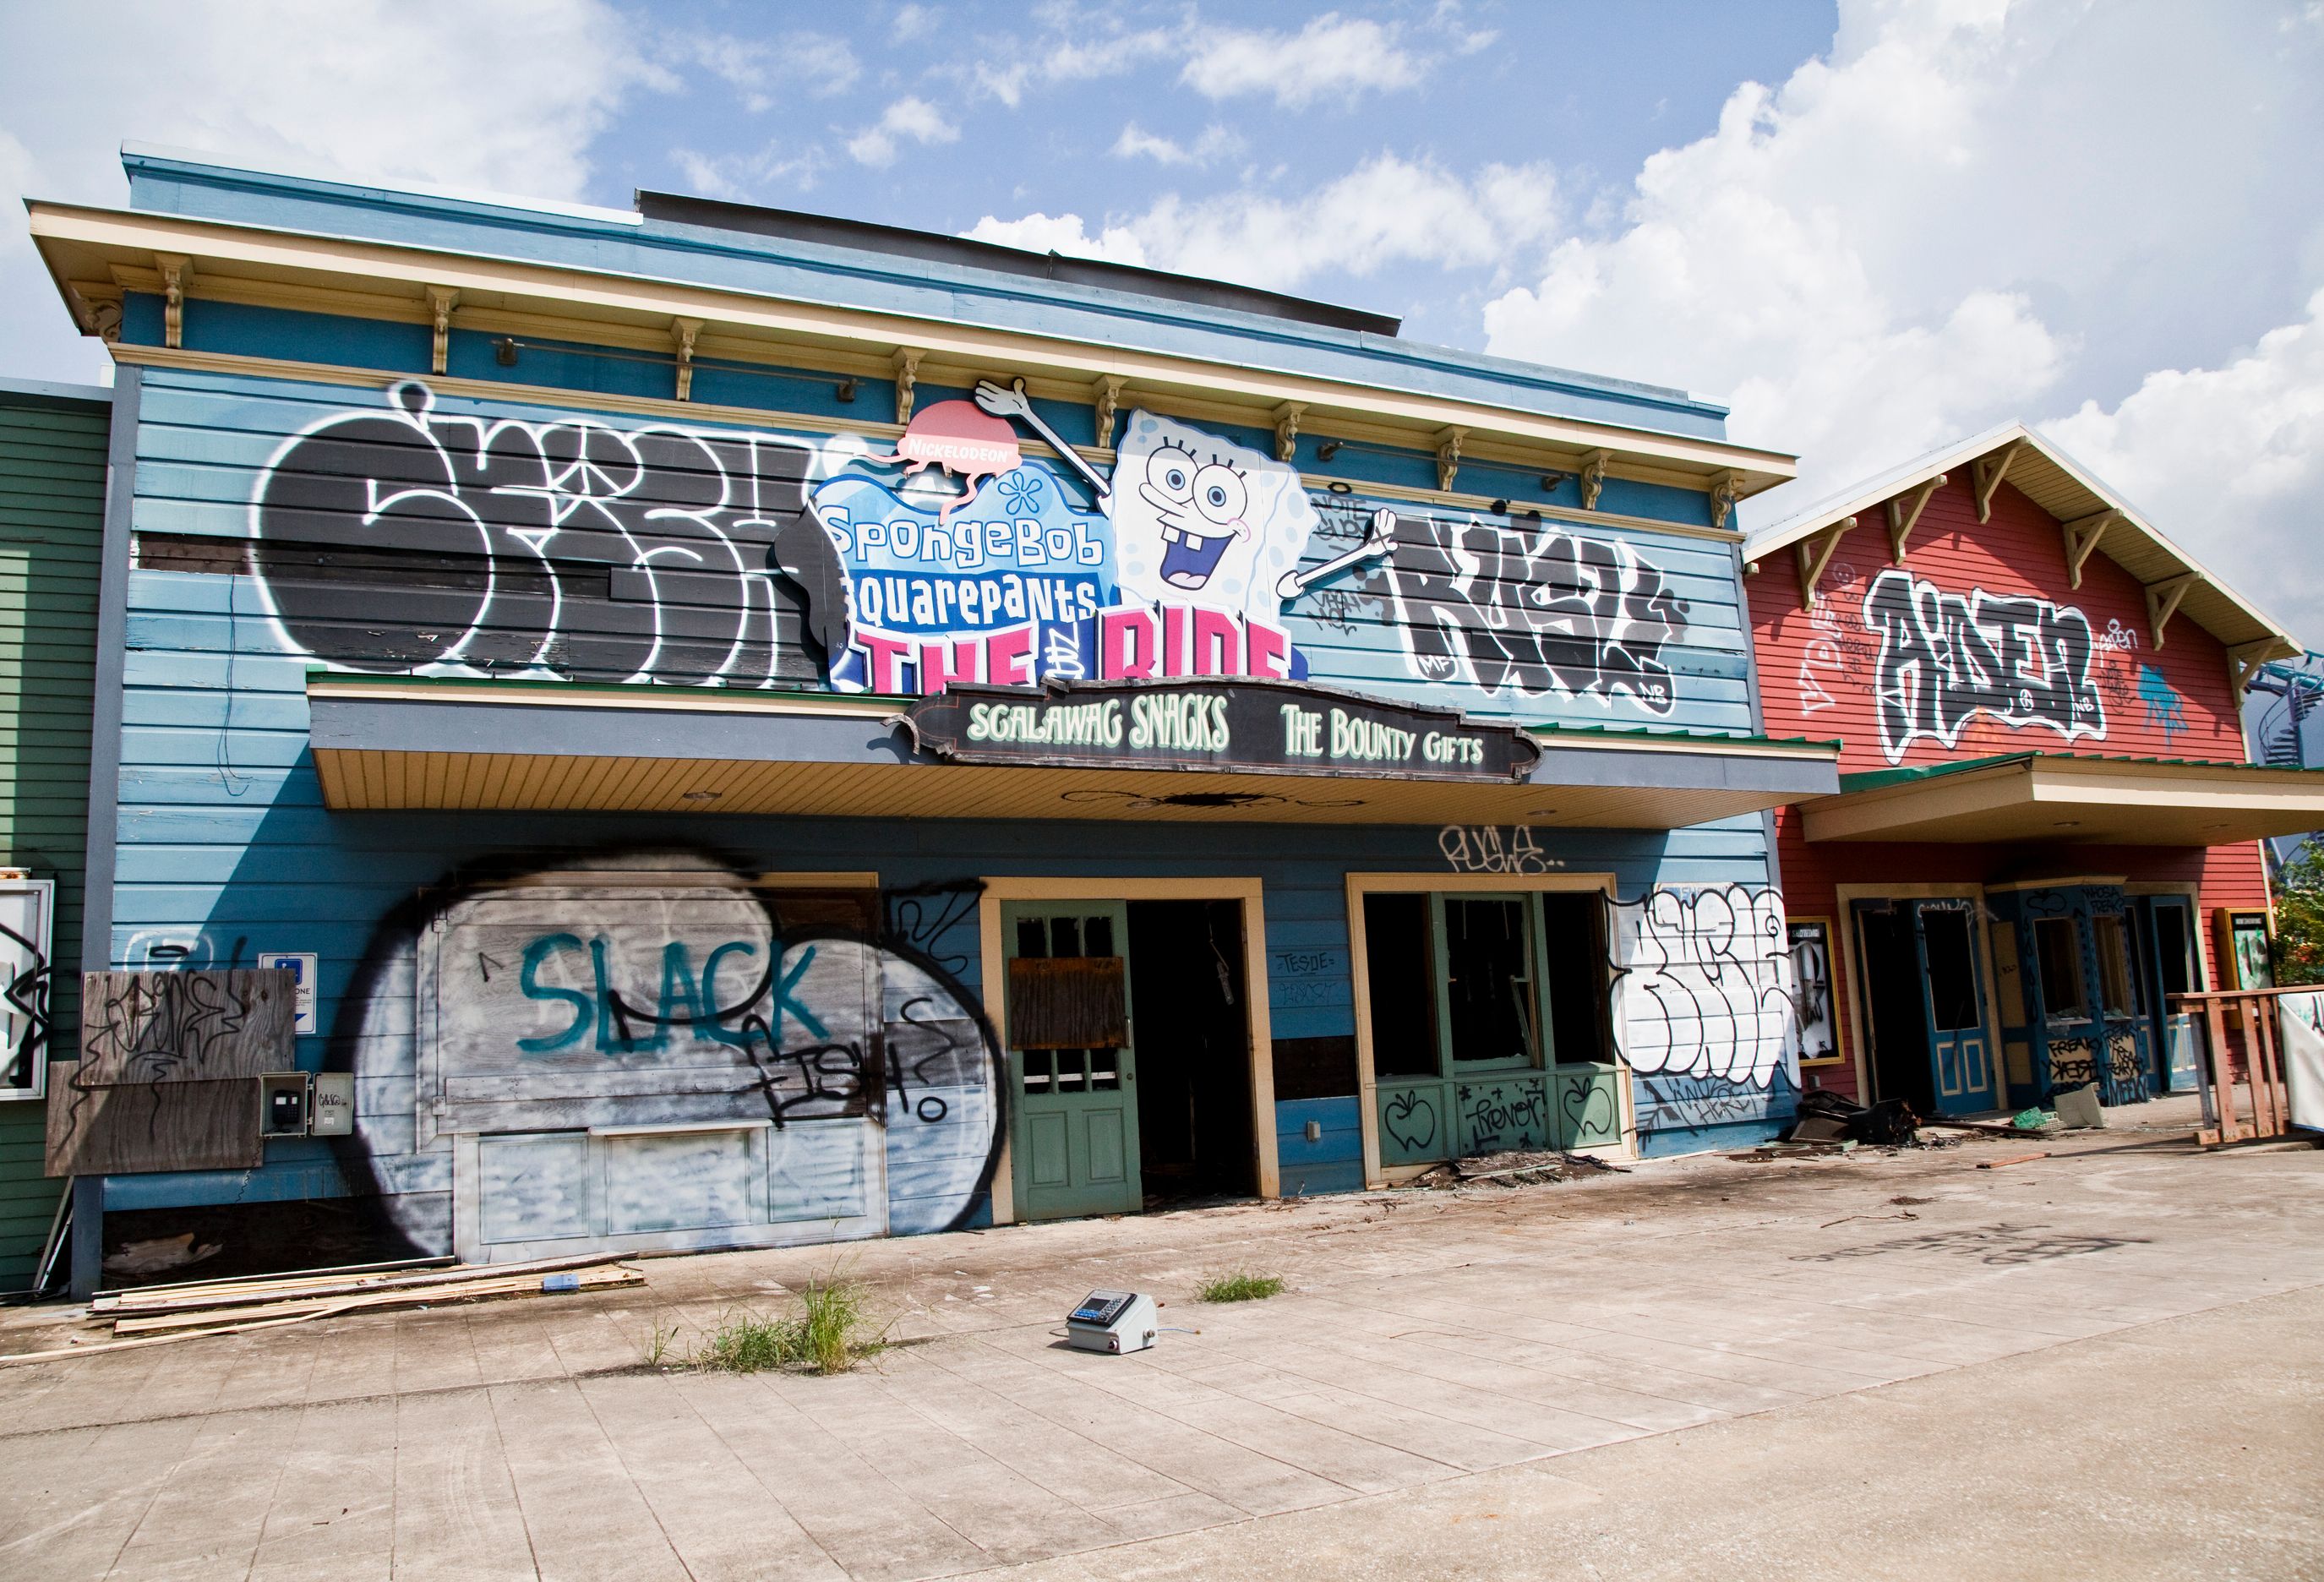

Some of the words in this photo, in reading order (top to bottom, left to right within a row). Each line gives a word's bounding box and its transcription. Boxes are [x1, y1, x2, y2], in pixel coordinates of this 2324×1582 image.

[850, 619, 1039, 695] THE
[1096, 599, 1292, 679] RIDE
[1128, 693, 1230, 752] SNACKS
[516, 932, 831, 1055] SLACK
